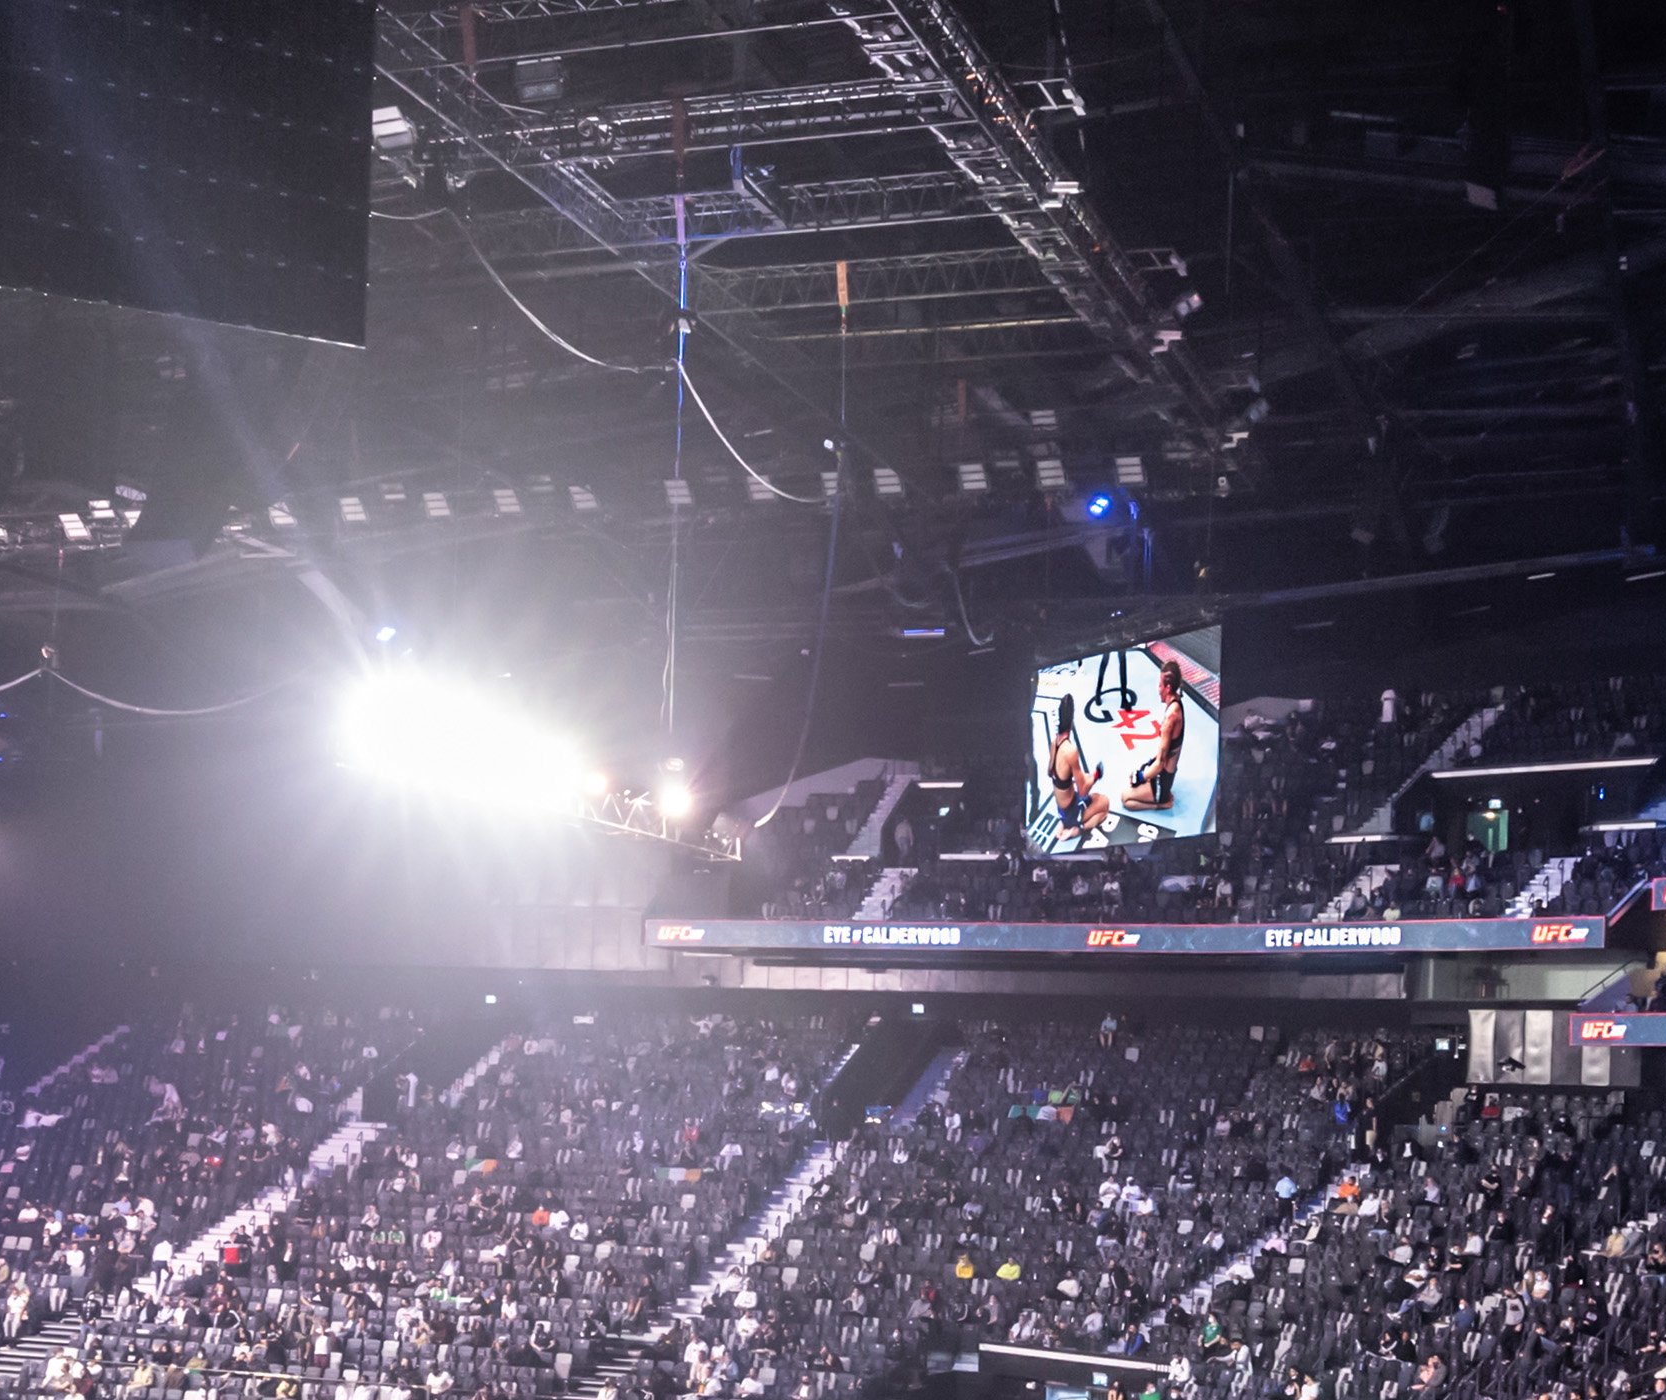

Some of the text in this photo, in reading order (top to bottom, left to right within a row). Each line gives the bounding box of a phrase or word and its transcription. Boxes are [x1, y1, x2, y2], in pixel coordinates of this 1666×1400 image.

[823, 926, 961, 945] EYE CALDERWOOD
[1087, 930, 1126, 946] UFC
[1265, 927, 1401, 947] EYE CALDERWOOD
[1532, 924, 1573, 944] UFC
[1581, 1021, 1619, 1040] UFC
